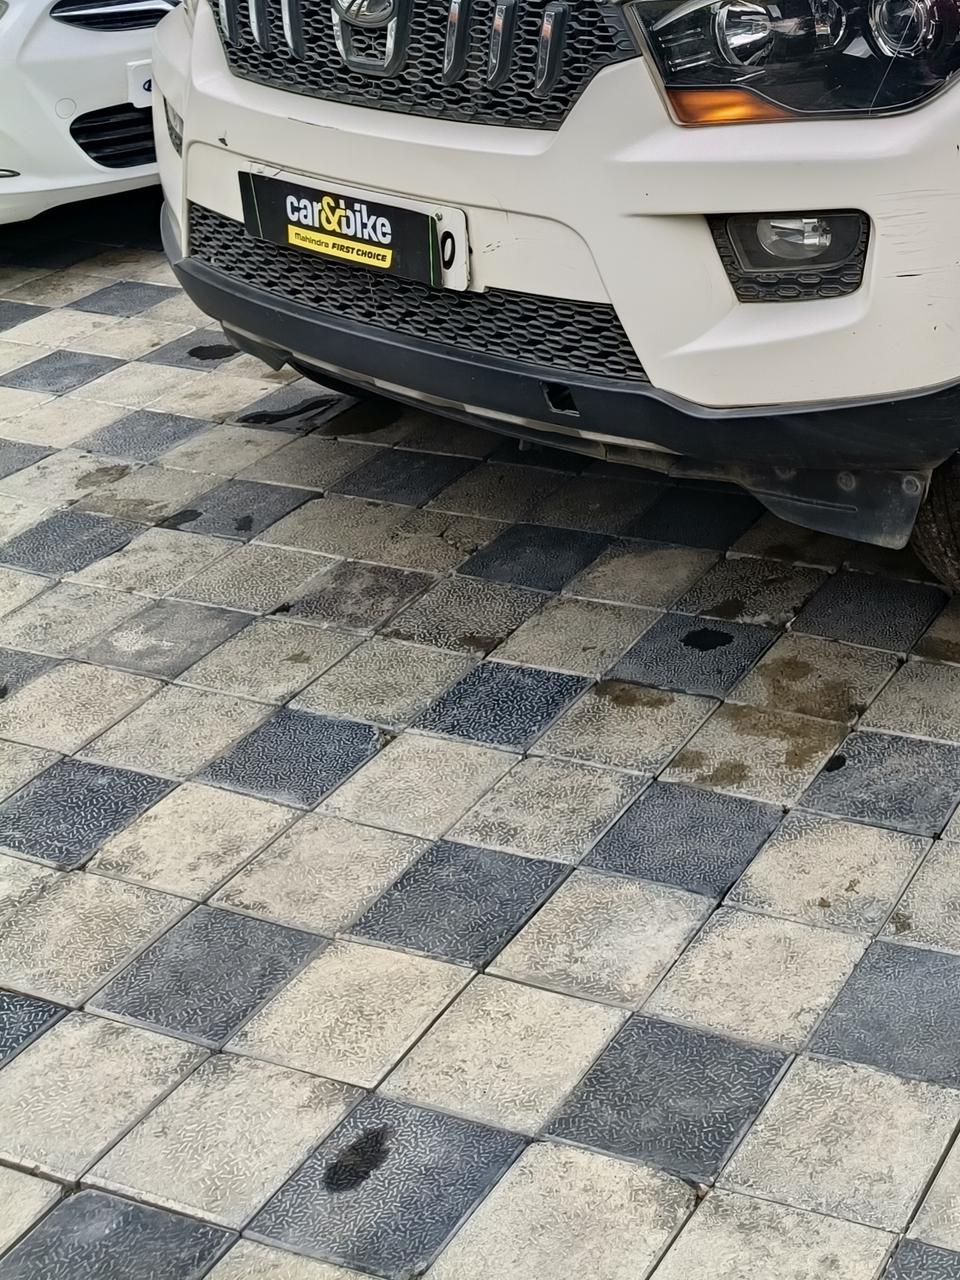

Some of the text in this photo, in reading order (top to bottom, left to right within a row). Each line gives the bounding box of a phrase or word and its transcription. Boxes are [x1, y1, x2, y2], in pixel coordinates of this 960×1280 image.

[286, 195, 392, 244] car&bike
[295, 232, 387, 263] Mahindra FIRST CHOICE
